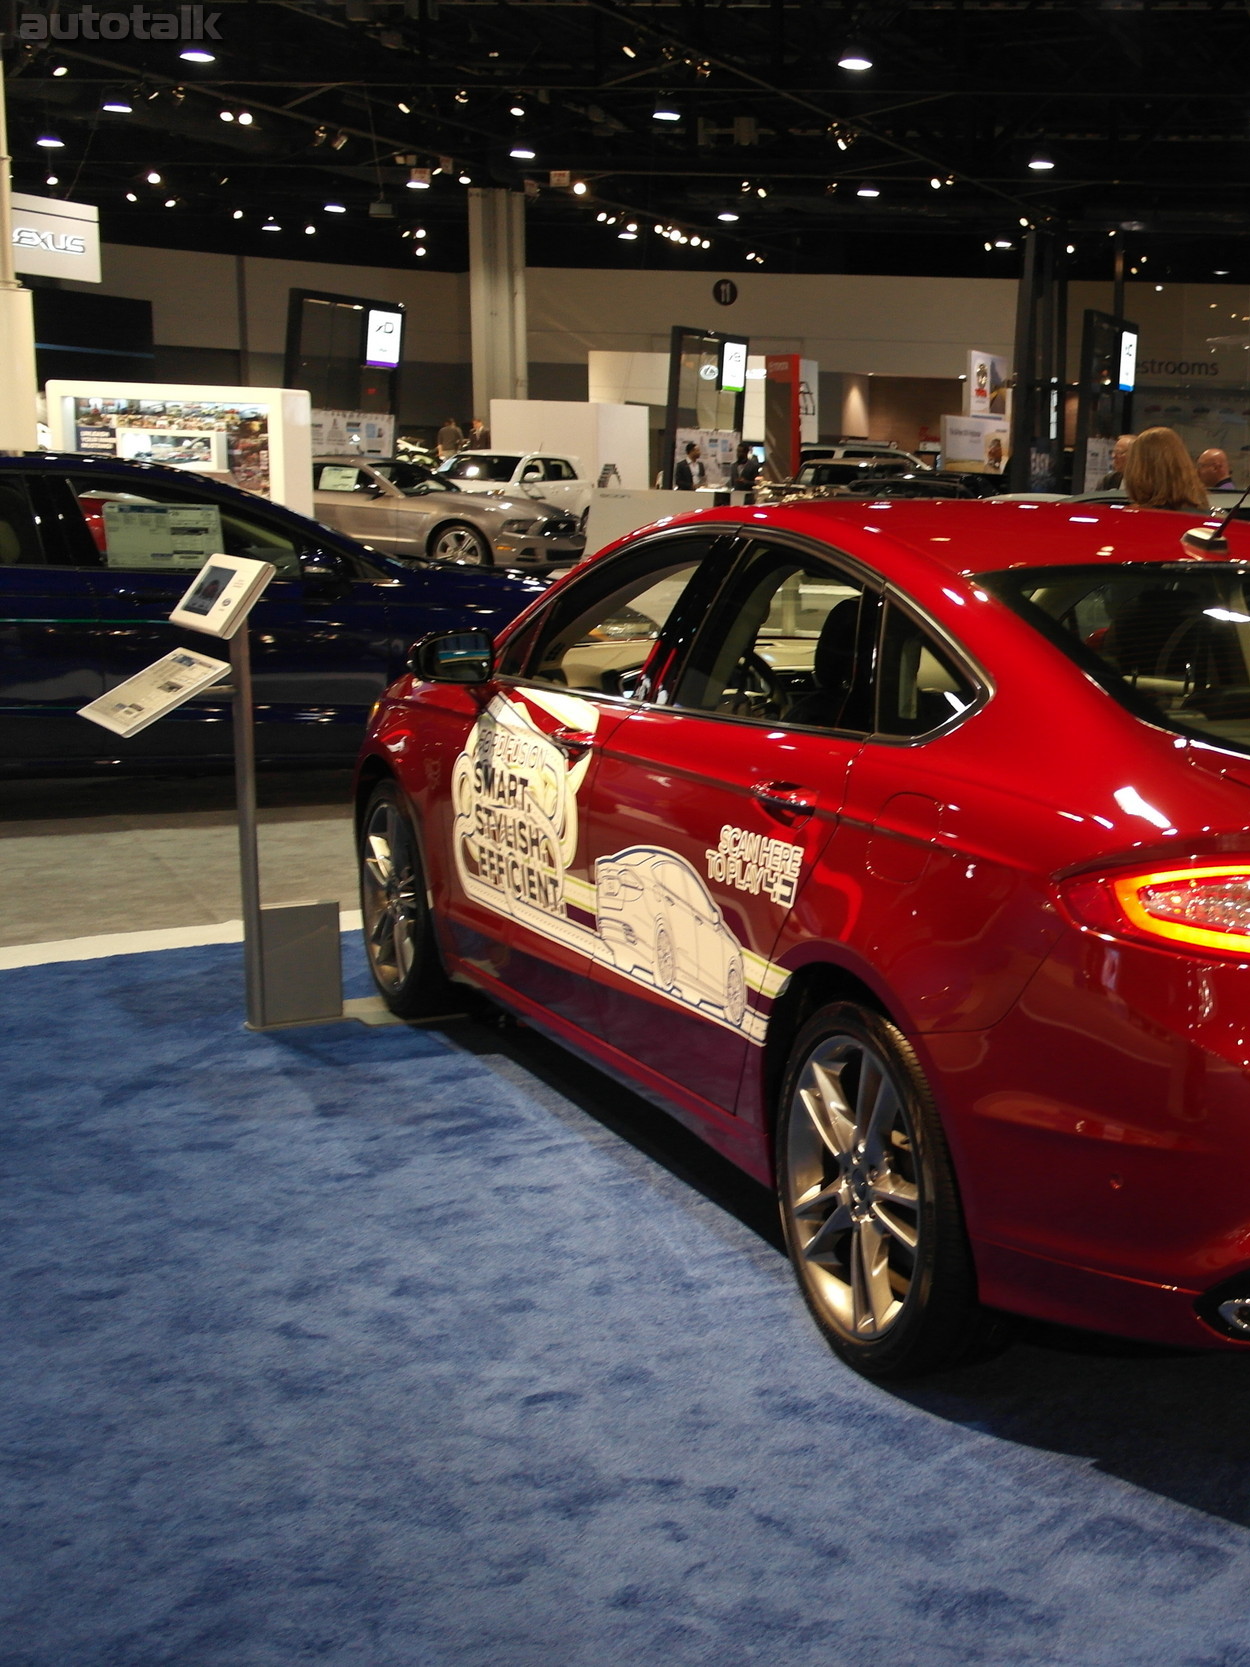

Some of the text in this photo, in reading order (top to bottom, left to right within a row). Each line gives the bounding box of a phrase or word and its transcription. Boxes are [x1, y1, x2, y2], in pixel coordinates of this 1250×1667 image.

[11, 227, 86, 255] EXUS
[1136, 359, 1219, 377] strooms
[718, 824, 805, 877] SCAN HERE
[705, 848, 765, 896] TO PLAY
